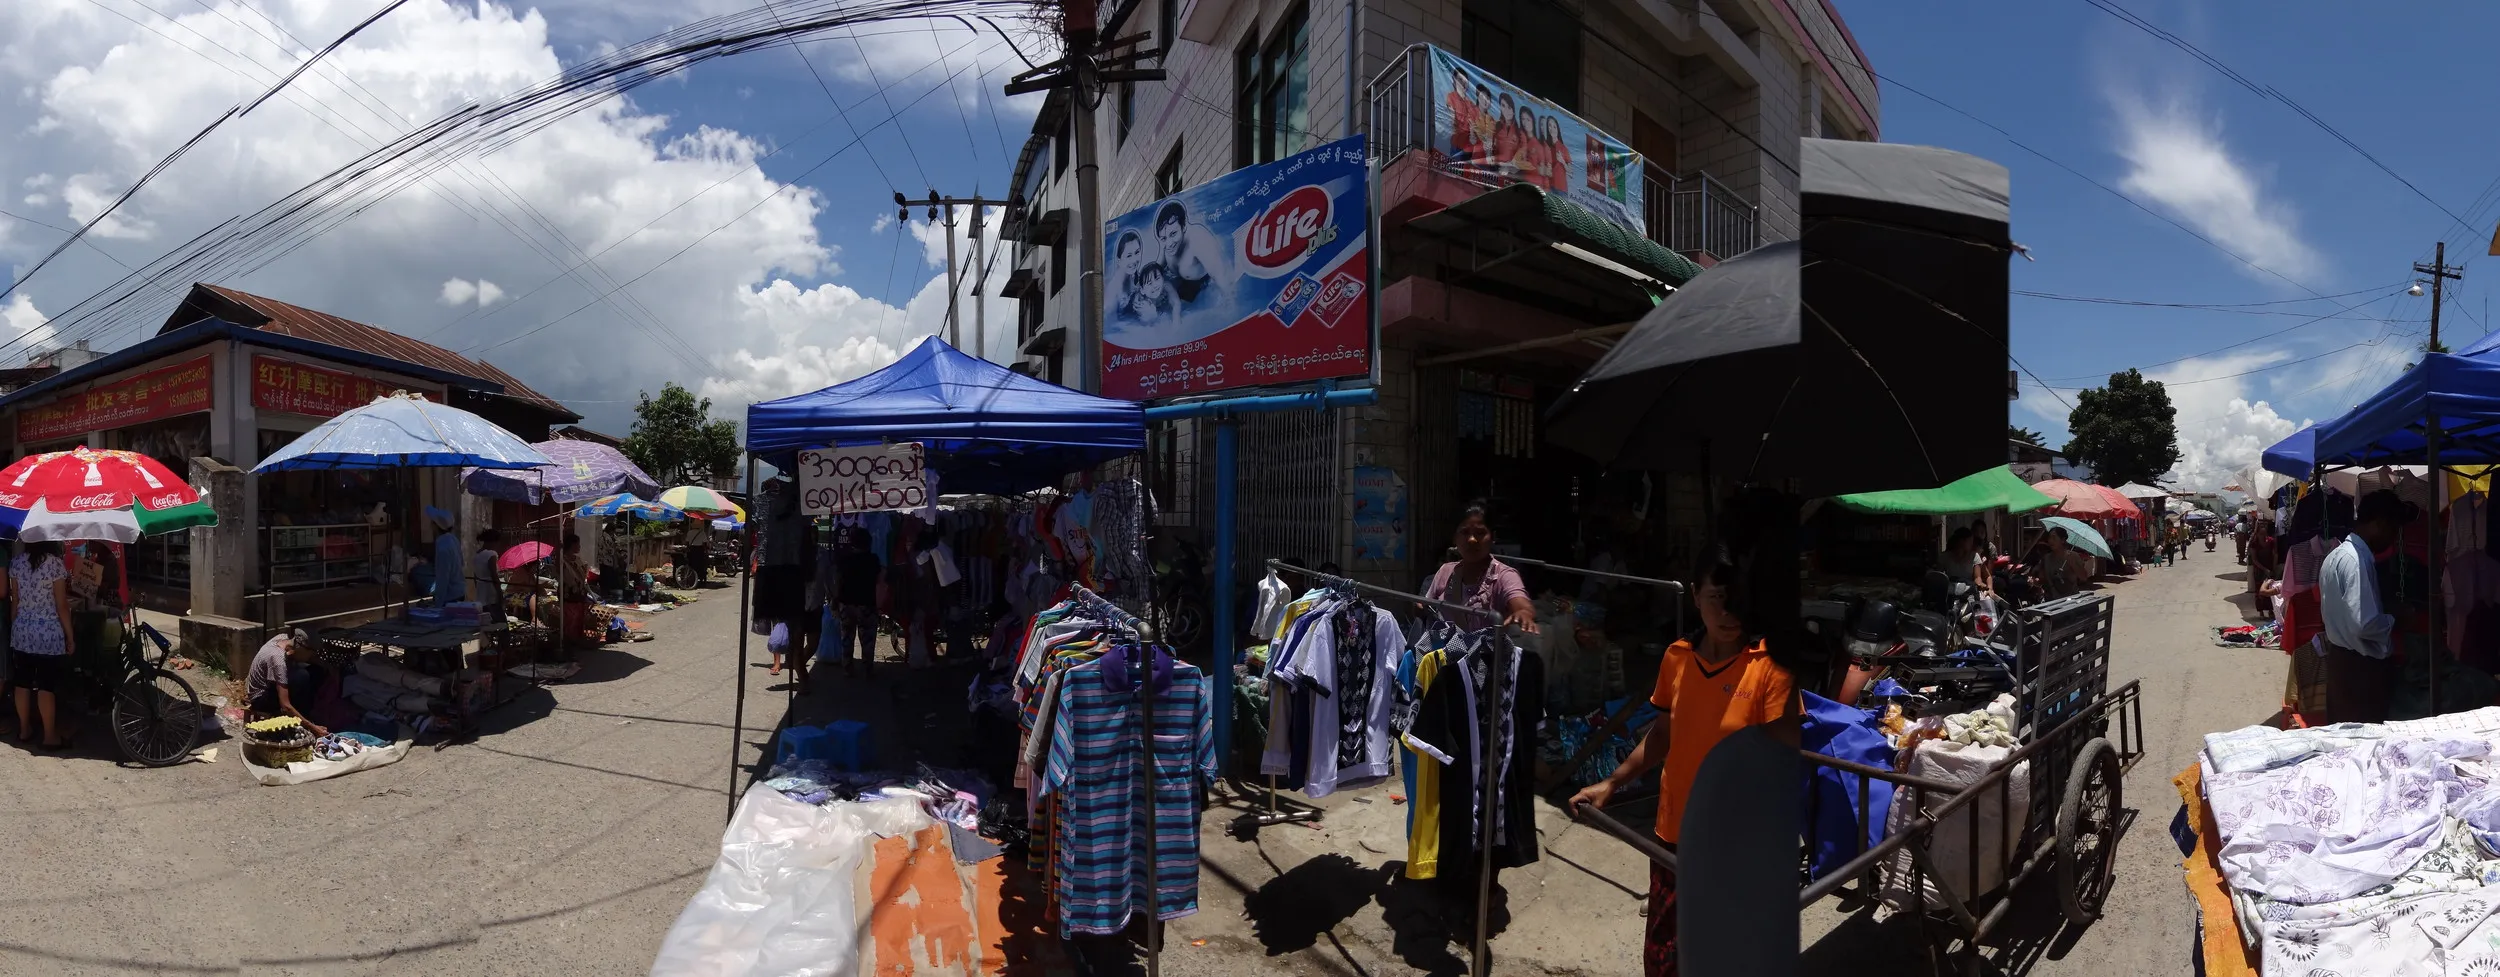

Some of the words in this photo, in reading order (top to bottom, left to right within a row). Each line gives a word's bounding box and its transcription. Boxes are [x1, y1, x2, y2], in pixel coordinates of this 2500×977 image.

[1183, 340, 1208, 354] 99.9%
[70, 492, 116, 508] Coca-Cola
[152, 491, 183, 508] Coca-Cola
